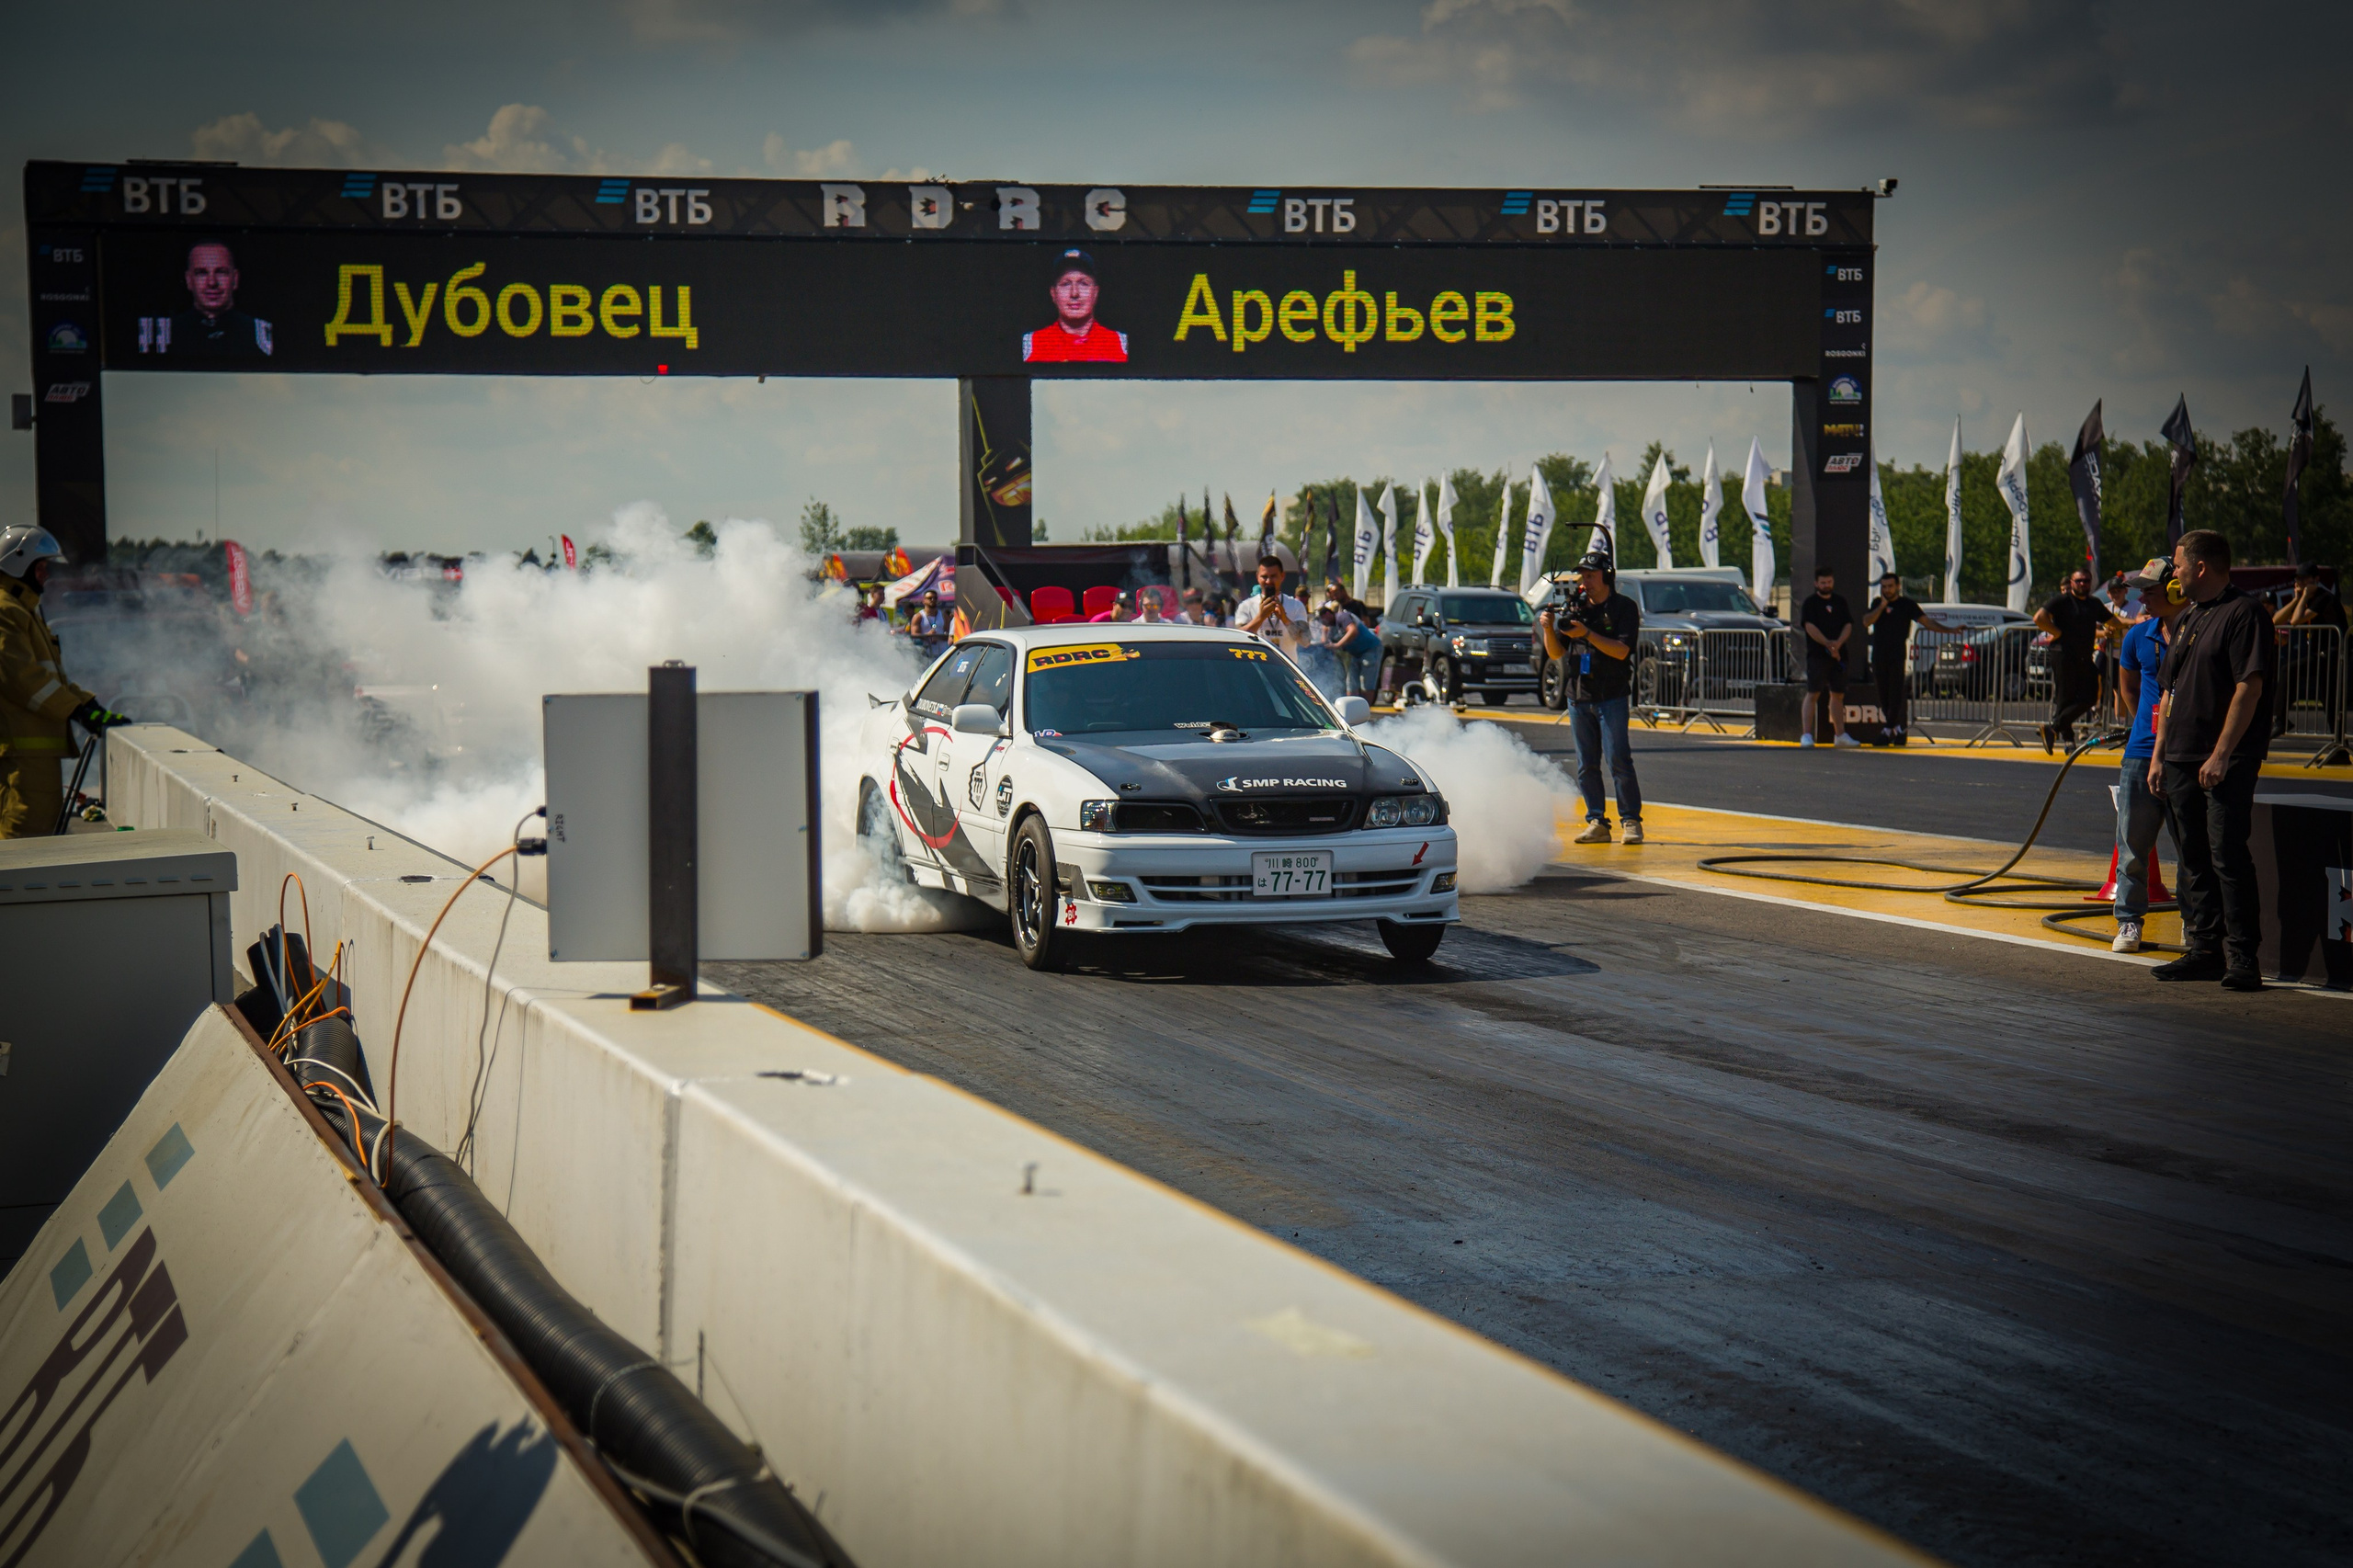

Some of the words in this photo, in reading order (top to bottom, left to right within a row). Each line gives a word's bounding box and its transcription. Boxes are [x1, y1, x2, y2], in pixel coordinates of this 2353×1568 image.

[122, 176, 207, 215] ВТБ
[382, 183, 463, 220] ВТБ
[634, 188, 714, 225] ВТБ
[821, 184, 1127, 232] RDRC
[1285, 199, 1357, 233] ВТБ
[1537, 199, 1607, 234] ВТБ
[1759, 201, 1828, 236] ВТБ
[52, 248, 85, 263] ВТБ
[1837, 267, 1863, 281] ВТБ
[324, 261, 699, 349] Дубовец
[1173, 269, 1517, 352] Арефьев
[1836, 310, 1862, 324] ВТБ
[1031, 649, 1111, 667] RDRC
[1228, 648, 1267, 661] 777
[1242, 778, 1279, 789] SMP
[1283, 778, 1347, 789] RACING
[1296, 857, 1317, 869] 800
[1257, 877, 1267, 888] は
[1270, 869, 1326, 892] 77-77
